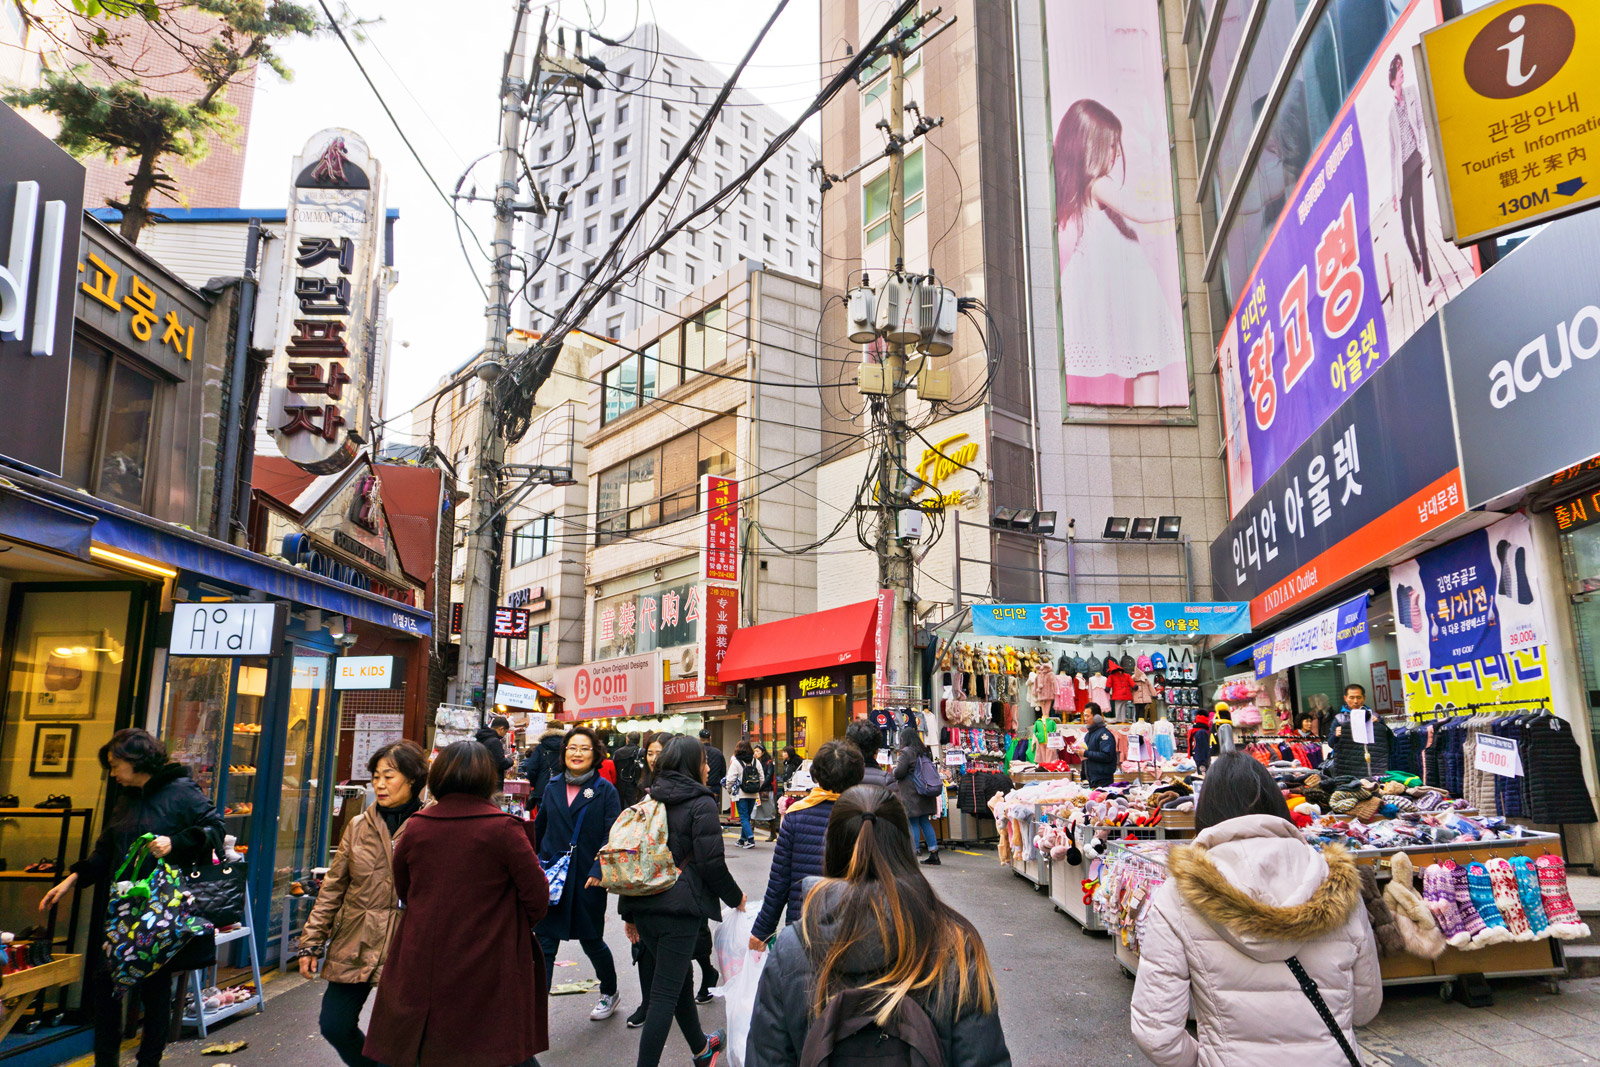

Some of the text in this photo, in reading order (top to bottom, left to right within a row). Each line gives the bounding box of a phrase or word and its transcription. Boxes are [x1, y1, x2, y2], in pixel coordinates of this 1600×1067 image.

[1488, 91, 1580, 144] 관광안내
[1461, 147, 1515, 176] Tourist
[1498, 187, 1550, 217] 130M
[78, 251, 195, 362] 고뭉치
[1240, 277, 1268, 344] 인디안
[1247, 191, 1366, 432] 창고형
[1329, 317, 1381, 393] 아울렛
[1232, 423, 1364, 588] 인디안 아울렛
[1417, 482, 1460, 524] 남대문점
[1264, 566, 1319, 613] INDIAN Outlet
[992, 607, 1027, 621] 인디안
[1040, 604, 1157, 633] 창고형
[1164, 617, 1200, 632] 아울렛
[1184, 605, 1238, 614] FACTORY OUTLET
[342, 665, 385, 677] EL KIDS
[612, 662, 630, 674] Original
[630, 660, 649, 671] Designs
